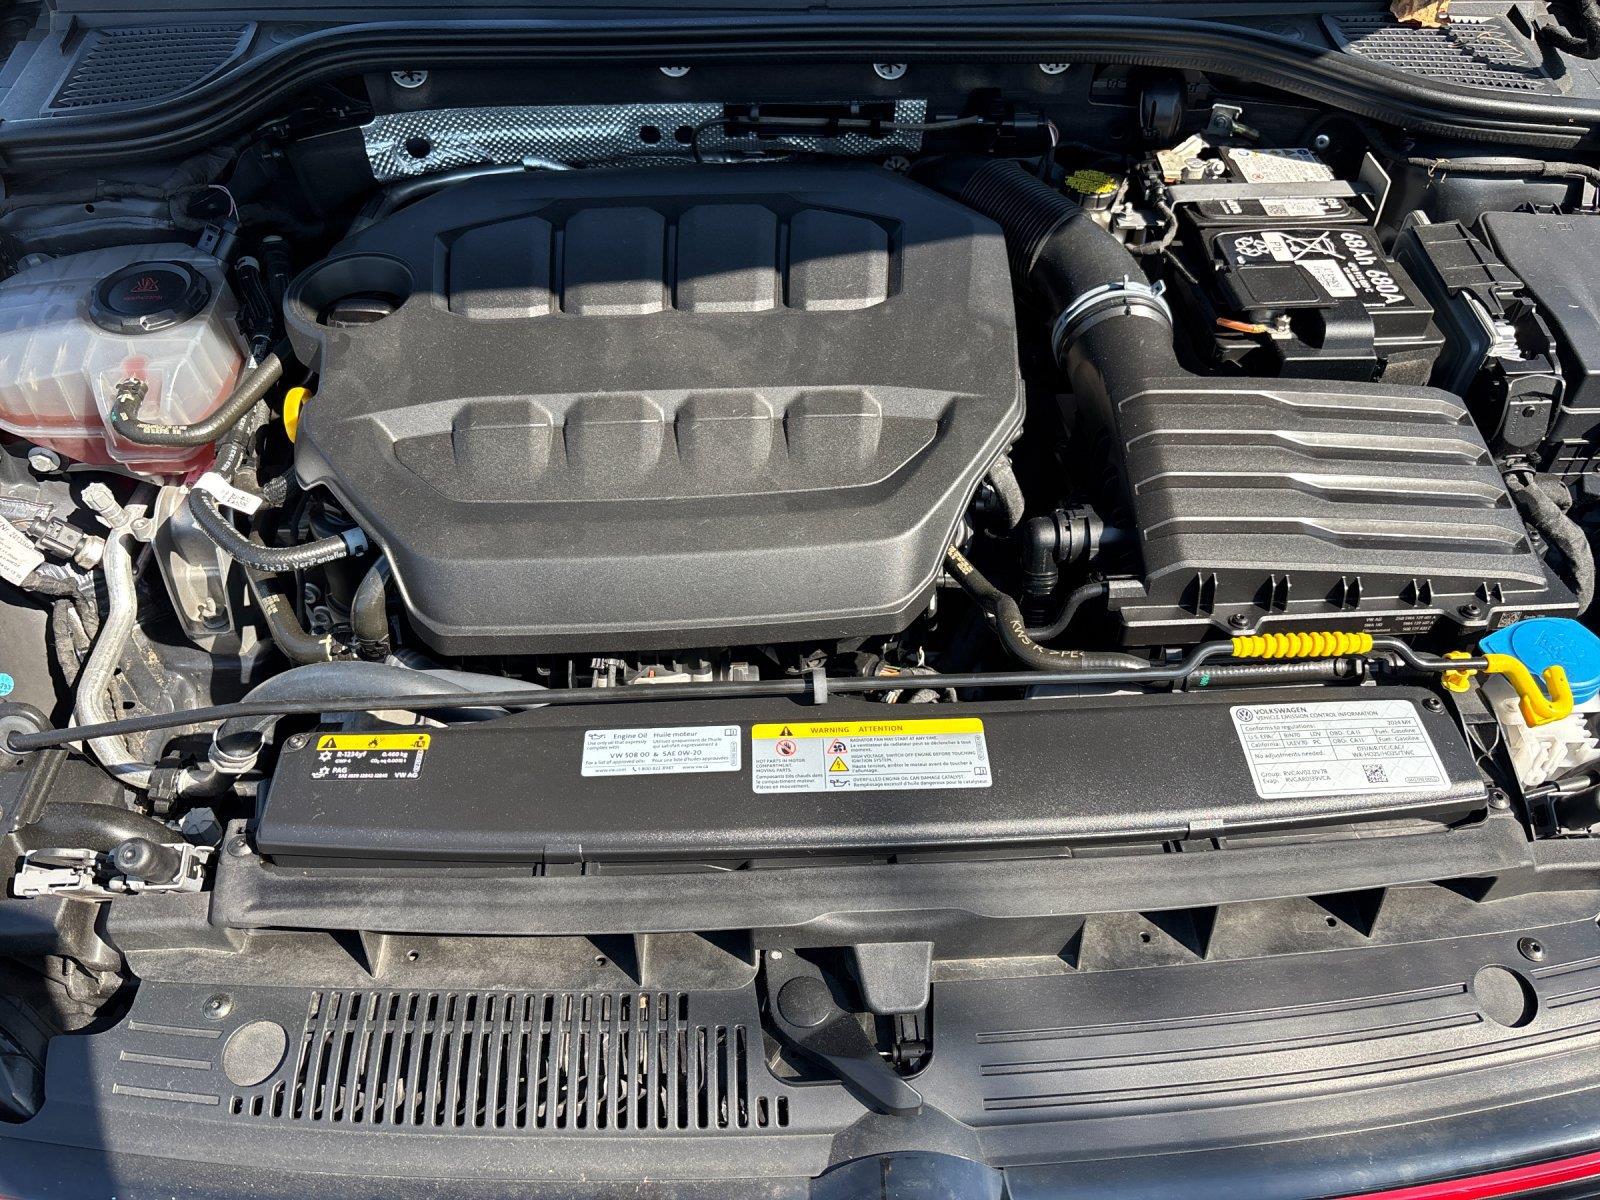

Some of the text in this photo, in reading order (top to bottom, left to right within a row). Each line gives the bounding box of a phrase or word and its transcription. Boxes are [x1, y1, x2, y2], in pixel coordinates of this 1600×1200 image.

[1340, 233, 1377, 265] 68Ah
[1365, 270, 1405, 304] 680A
[858, 724, 903, 732] ATTENTION
[337, 750, 367, 758] R-1234yf
[1265, 752, 1301, 760] adjustments
